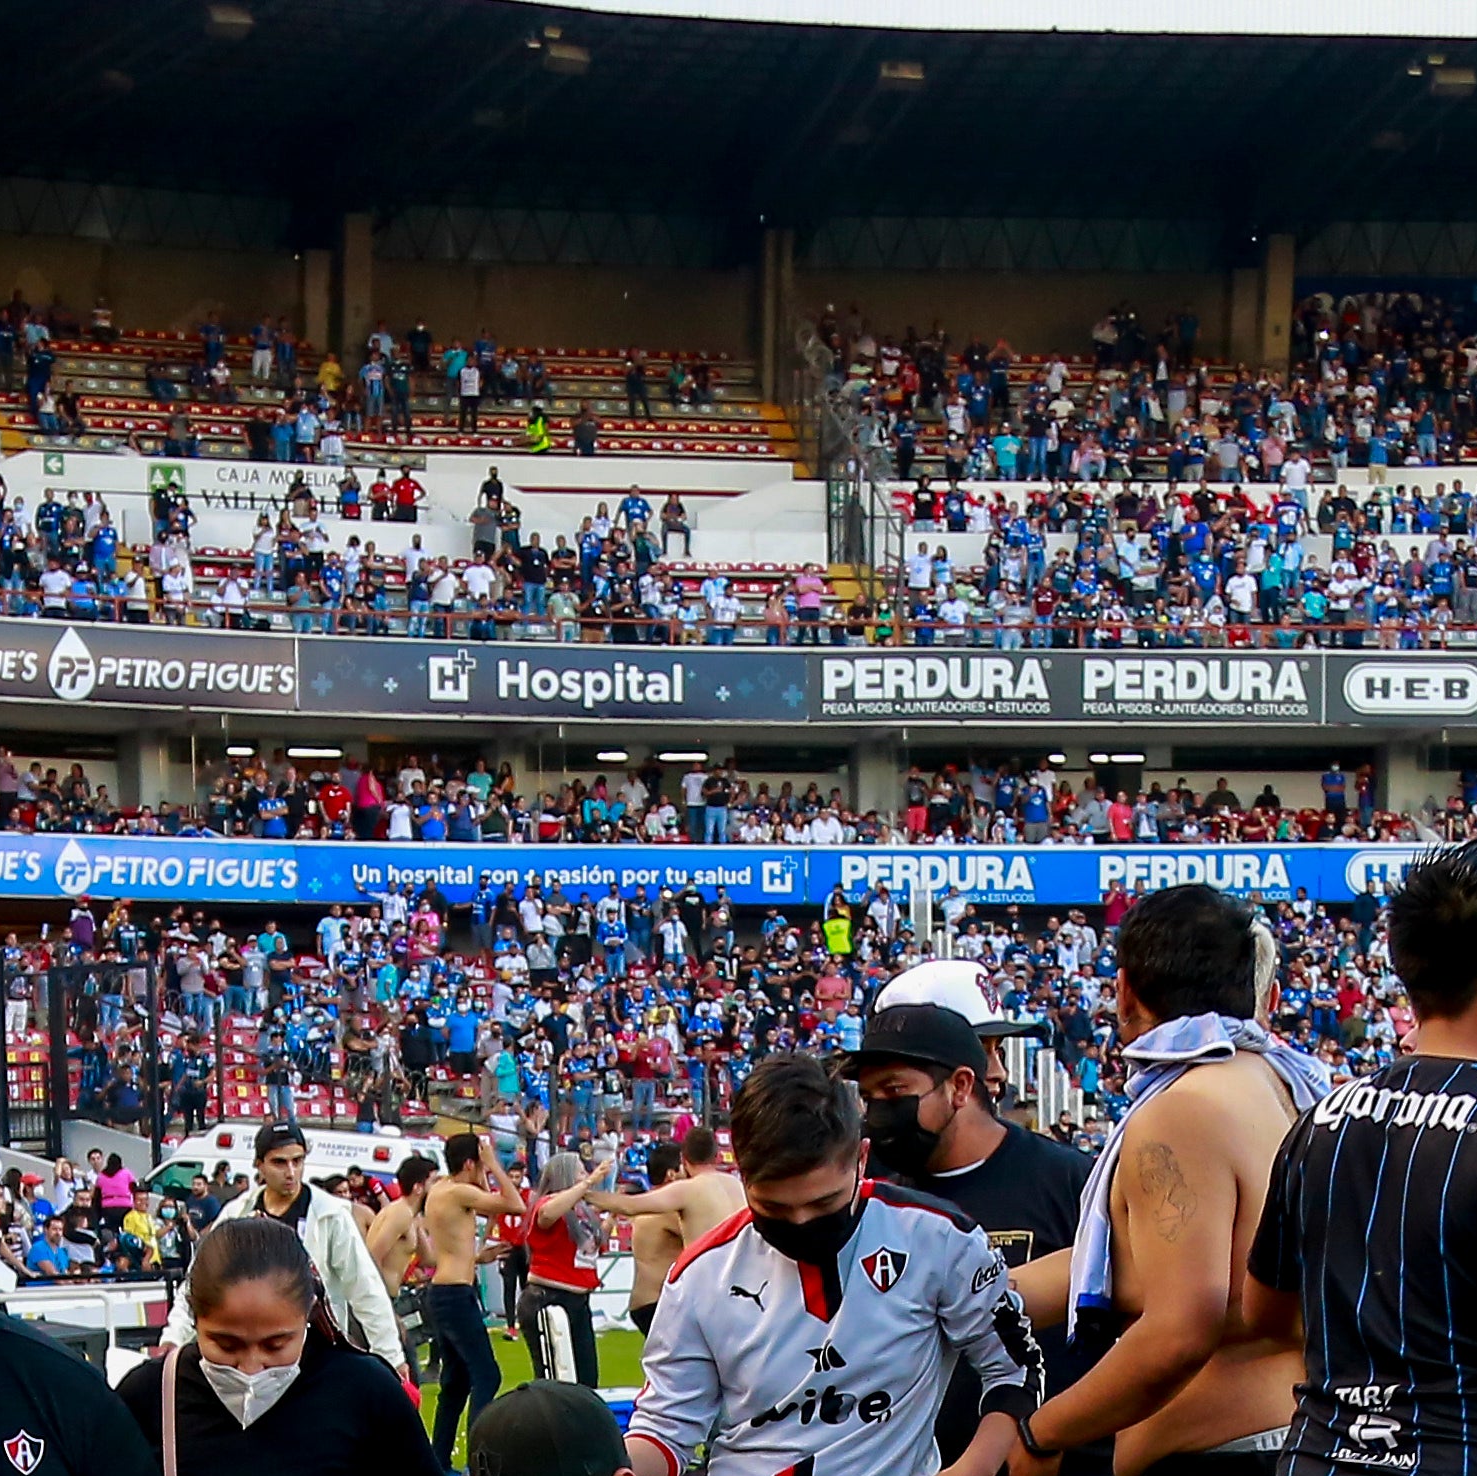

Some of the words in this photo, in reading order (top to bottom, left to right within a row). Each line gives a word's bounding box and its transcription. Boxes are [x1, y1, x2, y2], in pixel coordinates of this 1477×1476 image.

[217, 467, 261, 485] CAJA
[497, 659, 684, 708] Hospital
[823, 658, 1051, 701] PERDURA
[1083, 658, 1307, 701] PERDURA
[822, 703, 855, 715] PEGA
[857, 703, 893, 715] PISOS
[994, 702, 1051, 715] ESTUCOS
[1082, 703, 1116, 715] PEGA
[1118, 703, 1154, 715] PISOS
[1253, 703, 1308, 716] ESTUCOS
[352, 863, 381, 885] Un
[387, 862, 473, 888] hospital
[481, 867, 518, 885] con
[544, 861, 614, 890] pasión
[622, 869, 660, 891] por
[665, 864, 688, 885] tu
[694, 862, 751, 886] salud
[842, 856, 1035, 891] PERDURA
[987, 893, 1036, 904] ESTUCOS
[1313, 1077, 1476, 1132] Corona
